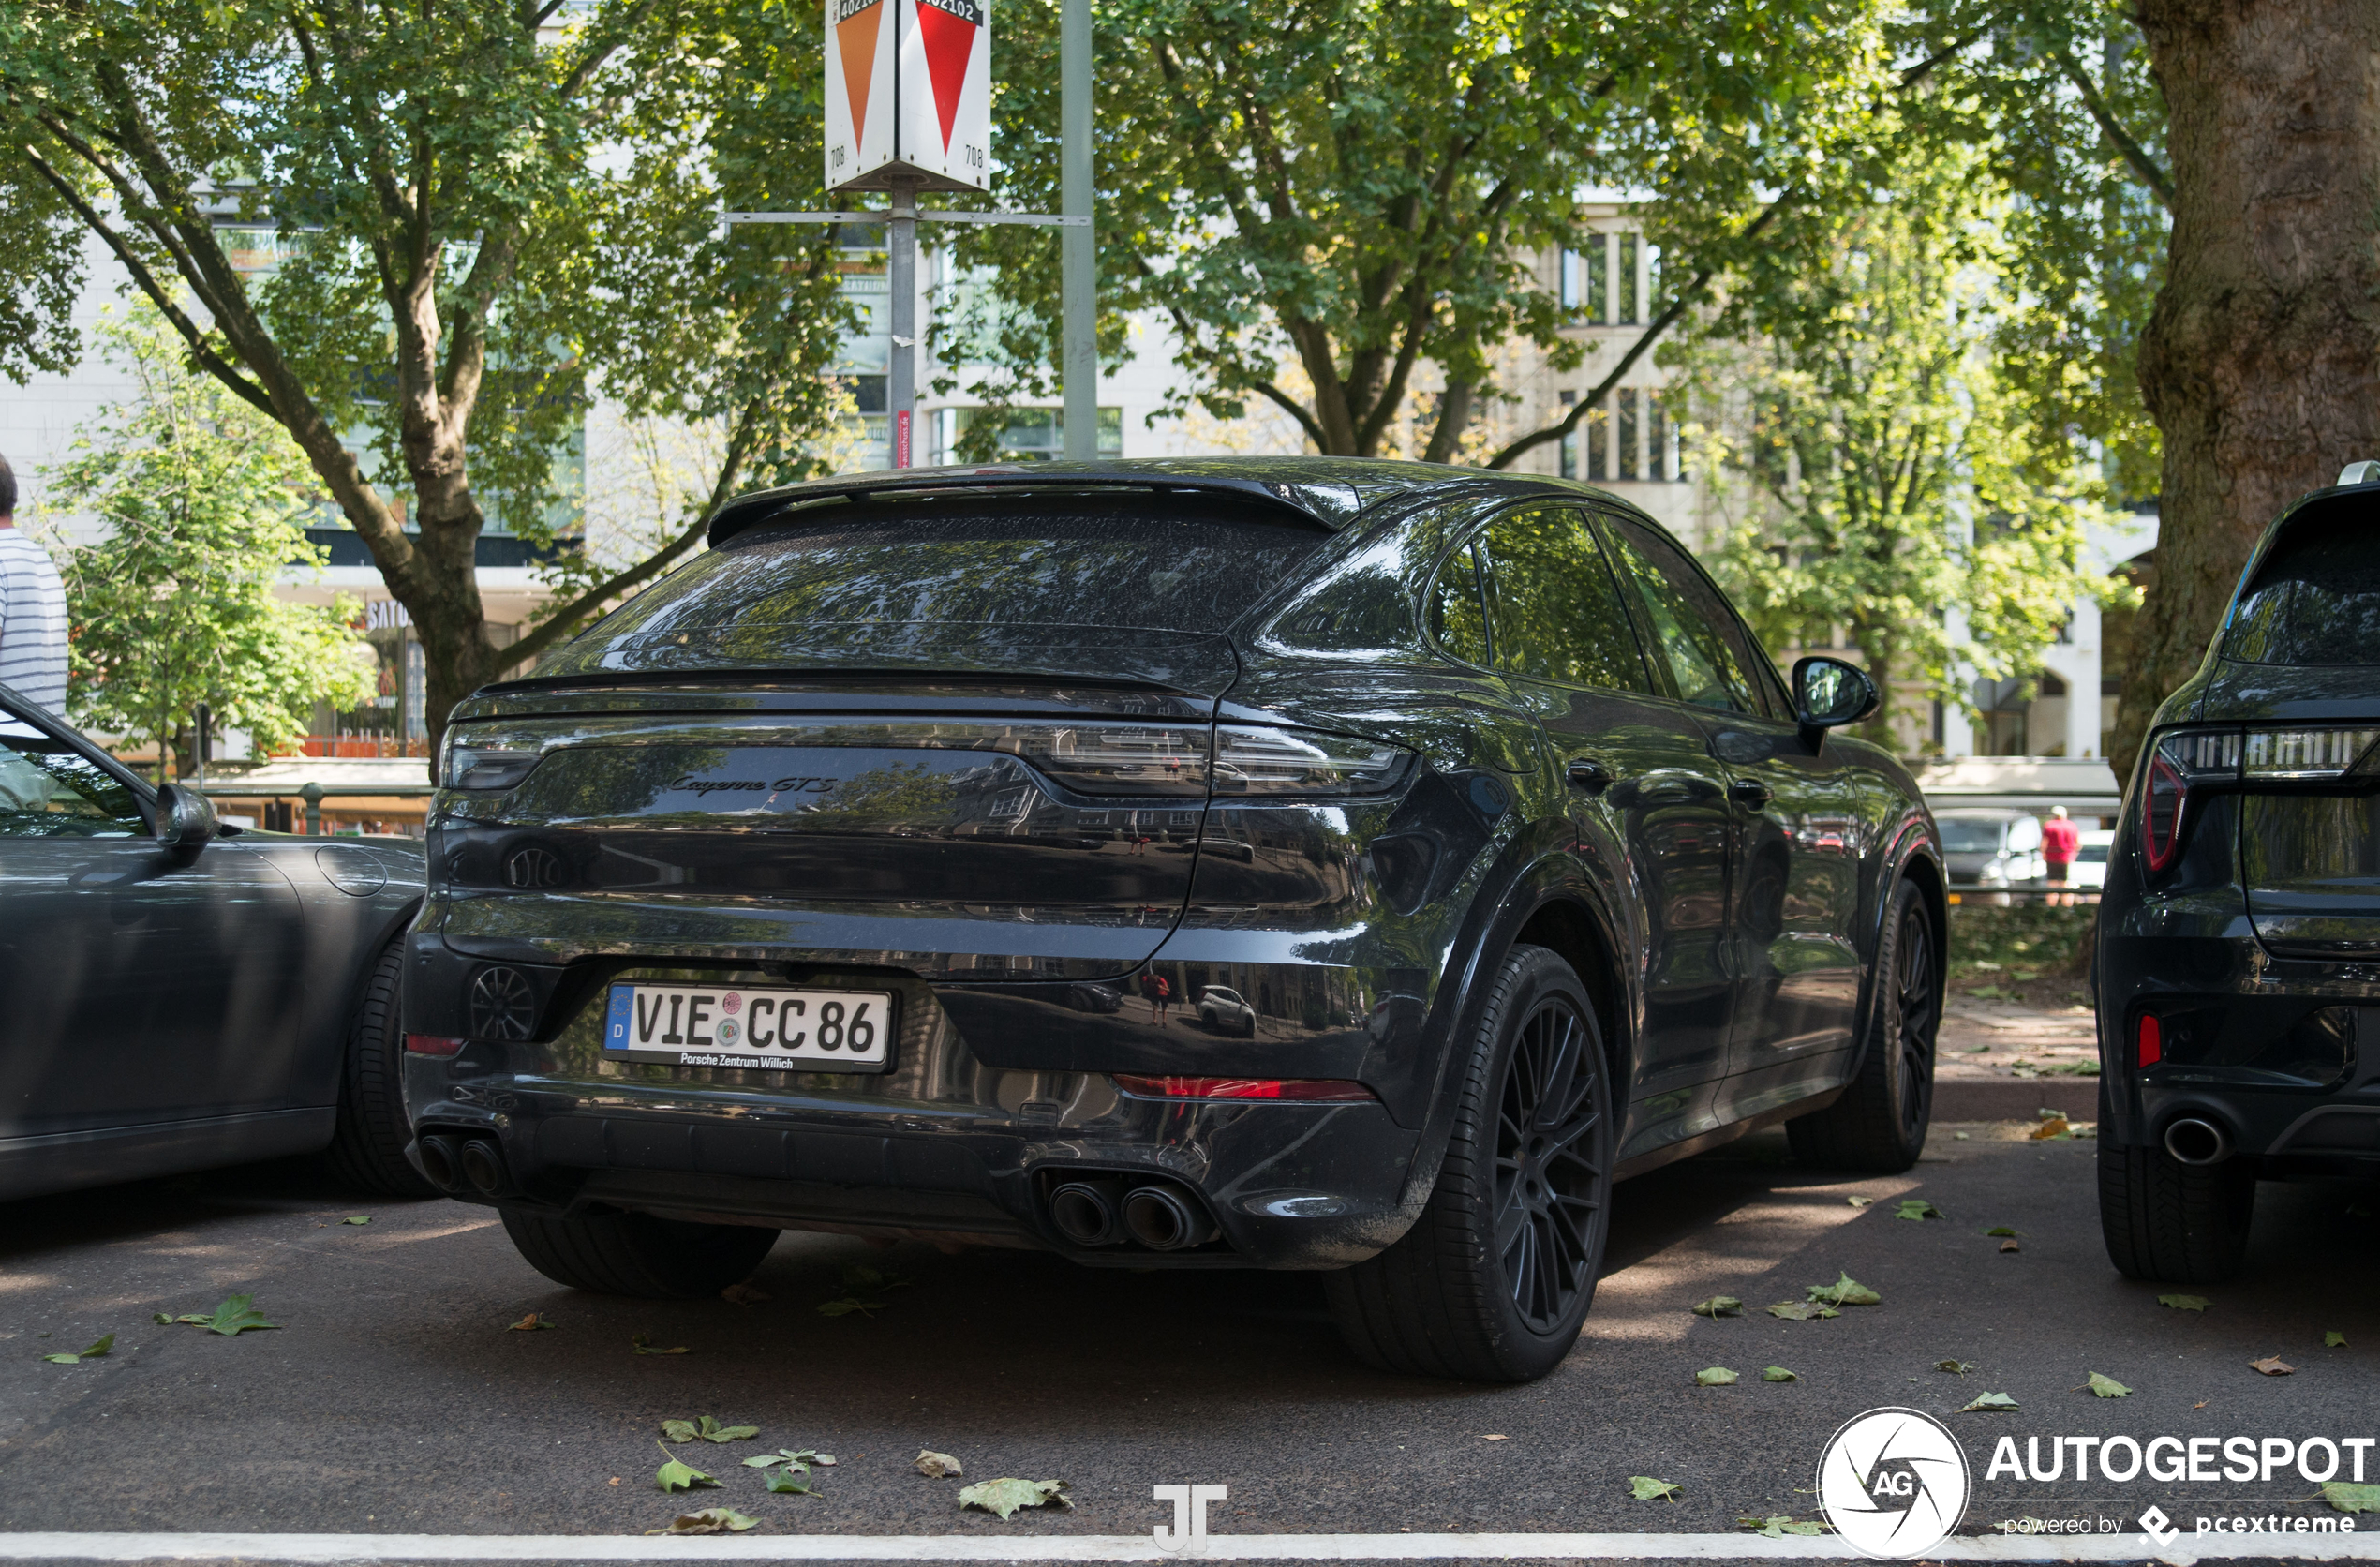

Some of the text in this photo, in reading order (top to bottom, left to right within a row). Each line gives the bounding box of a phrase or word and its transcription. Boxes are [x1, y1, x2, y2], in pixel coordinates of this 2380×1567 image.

[831, 145, 845, 170] 708
[965, 144, 983, 168] 708
[367, 600, 414, 629] SATU
[669, 775, 838, 797] Cayenne GTS
[613, 1024, 623, 1038] D
[637, 993, 716, 1045] VIE
[747, 998, 806, 1050] CC
[817, 1001, 875, 1052] 86
[680, 1052, 794, 1069] Porsche Zentrum Willich
